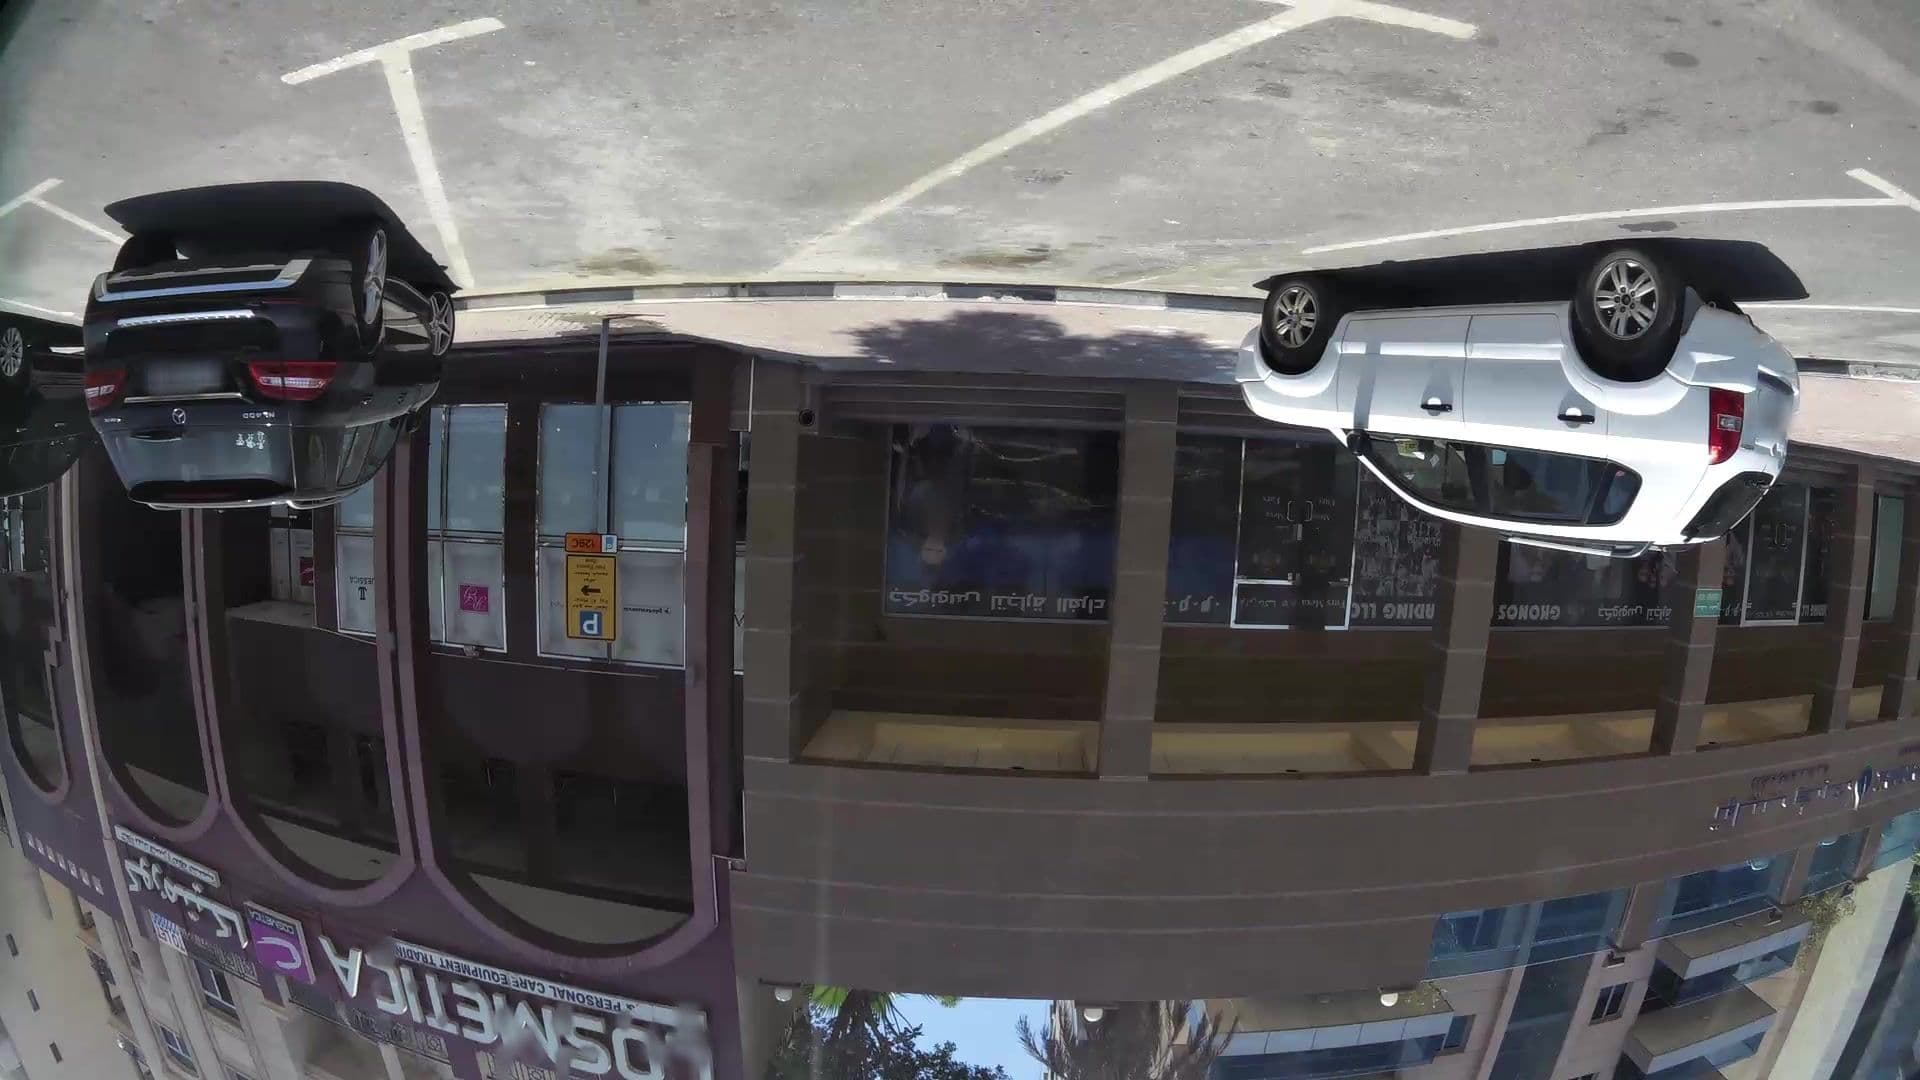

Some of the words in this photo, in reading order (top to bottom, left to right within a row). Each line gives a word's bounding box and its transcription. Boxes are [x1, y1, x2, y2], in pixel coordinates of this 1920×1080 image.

[888, 588, 980, 608] جكونوس
[991, 592, 1047, 611] لتجارة
[1056, 594, 1106, 614] الفراء
[582, 613, 599, 635] P
[393, 945, 436, 966] TRADIN
[438, 958, 509, 986] EQUIPMENT
[509, 976, 546, 995] CARE
[548, 985, 621, 1013] PERSONAL
